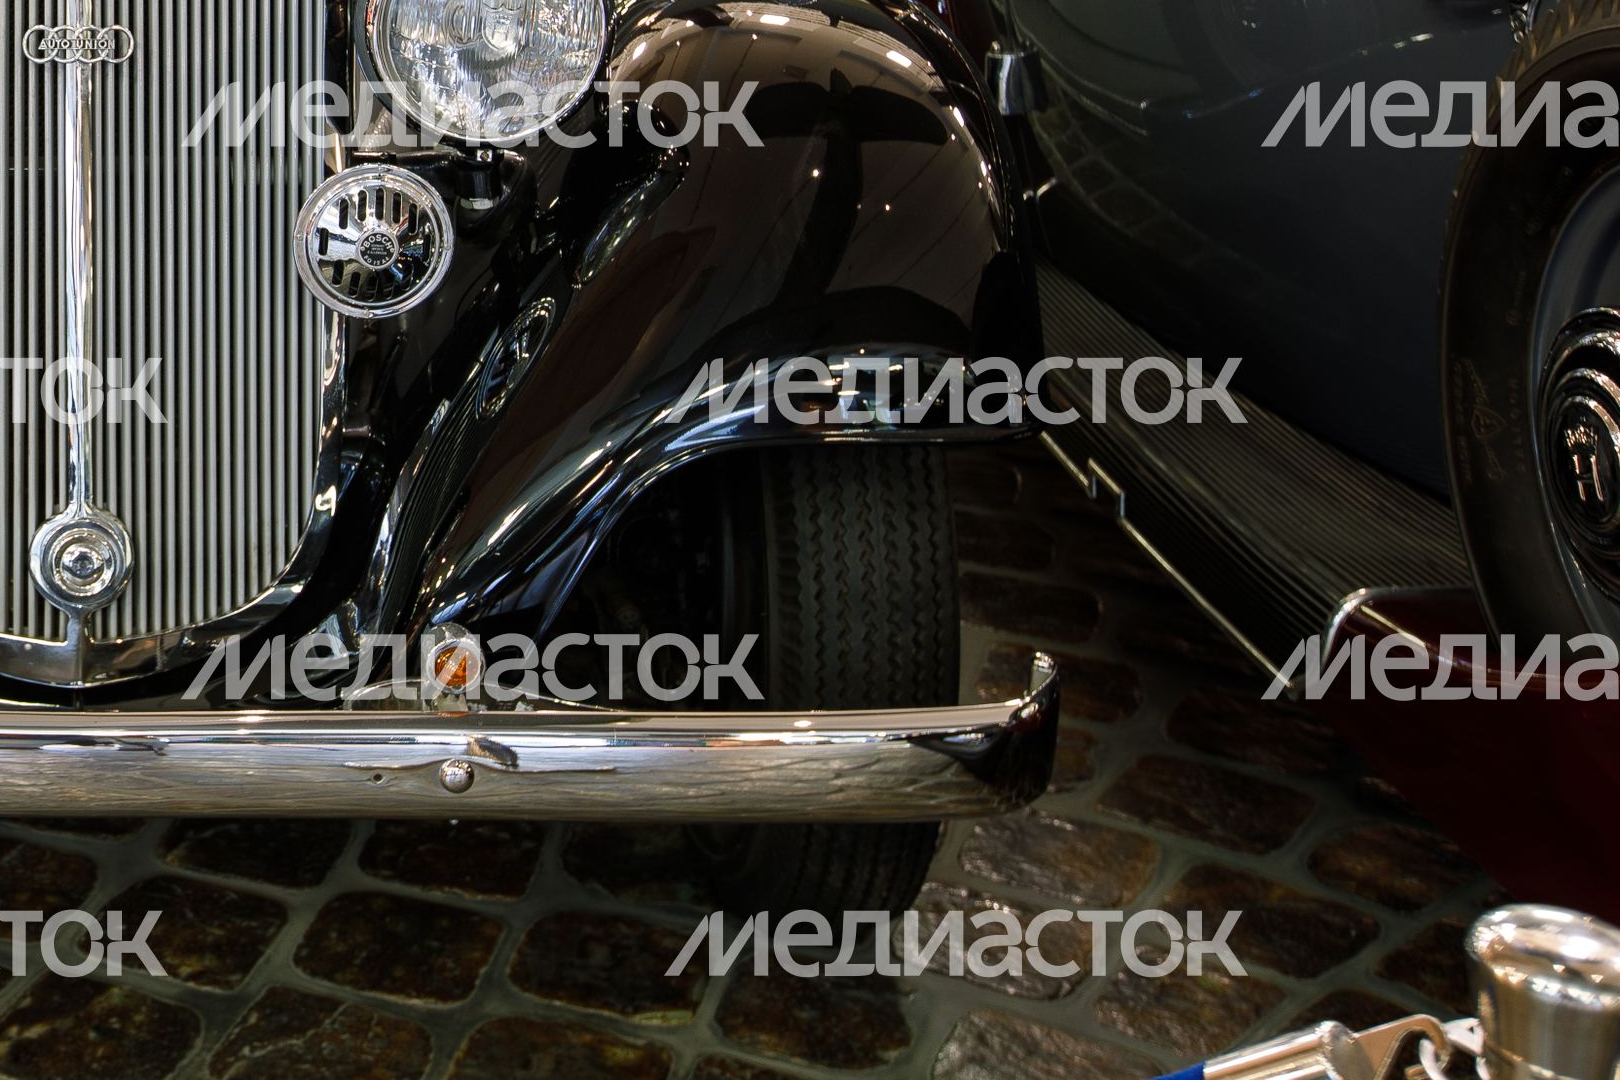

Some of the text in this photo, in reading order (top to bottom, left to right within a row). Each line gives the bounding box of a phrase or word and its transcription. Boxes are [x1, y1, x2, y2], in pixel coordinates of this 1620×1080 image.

[38, 38, 115, 50] AUTO UNION
[363, 234, 393, 249] BOSCH
